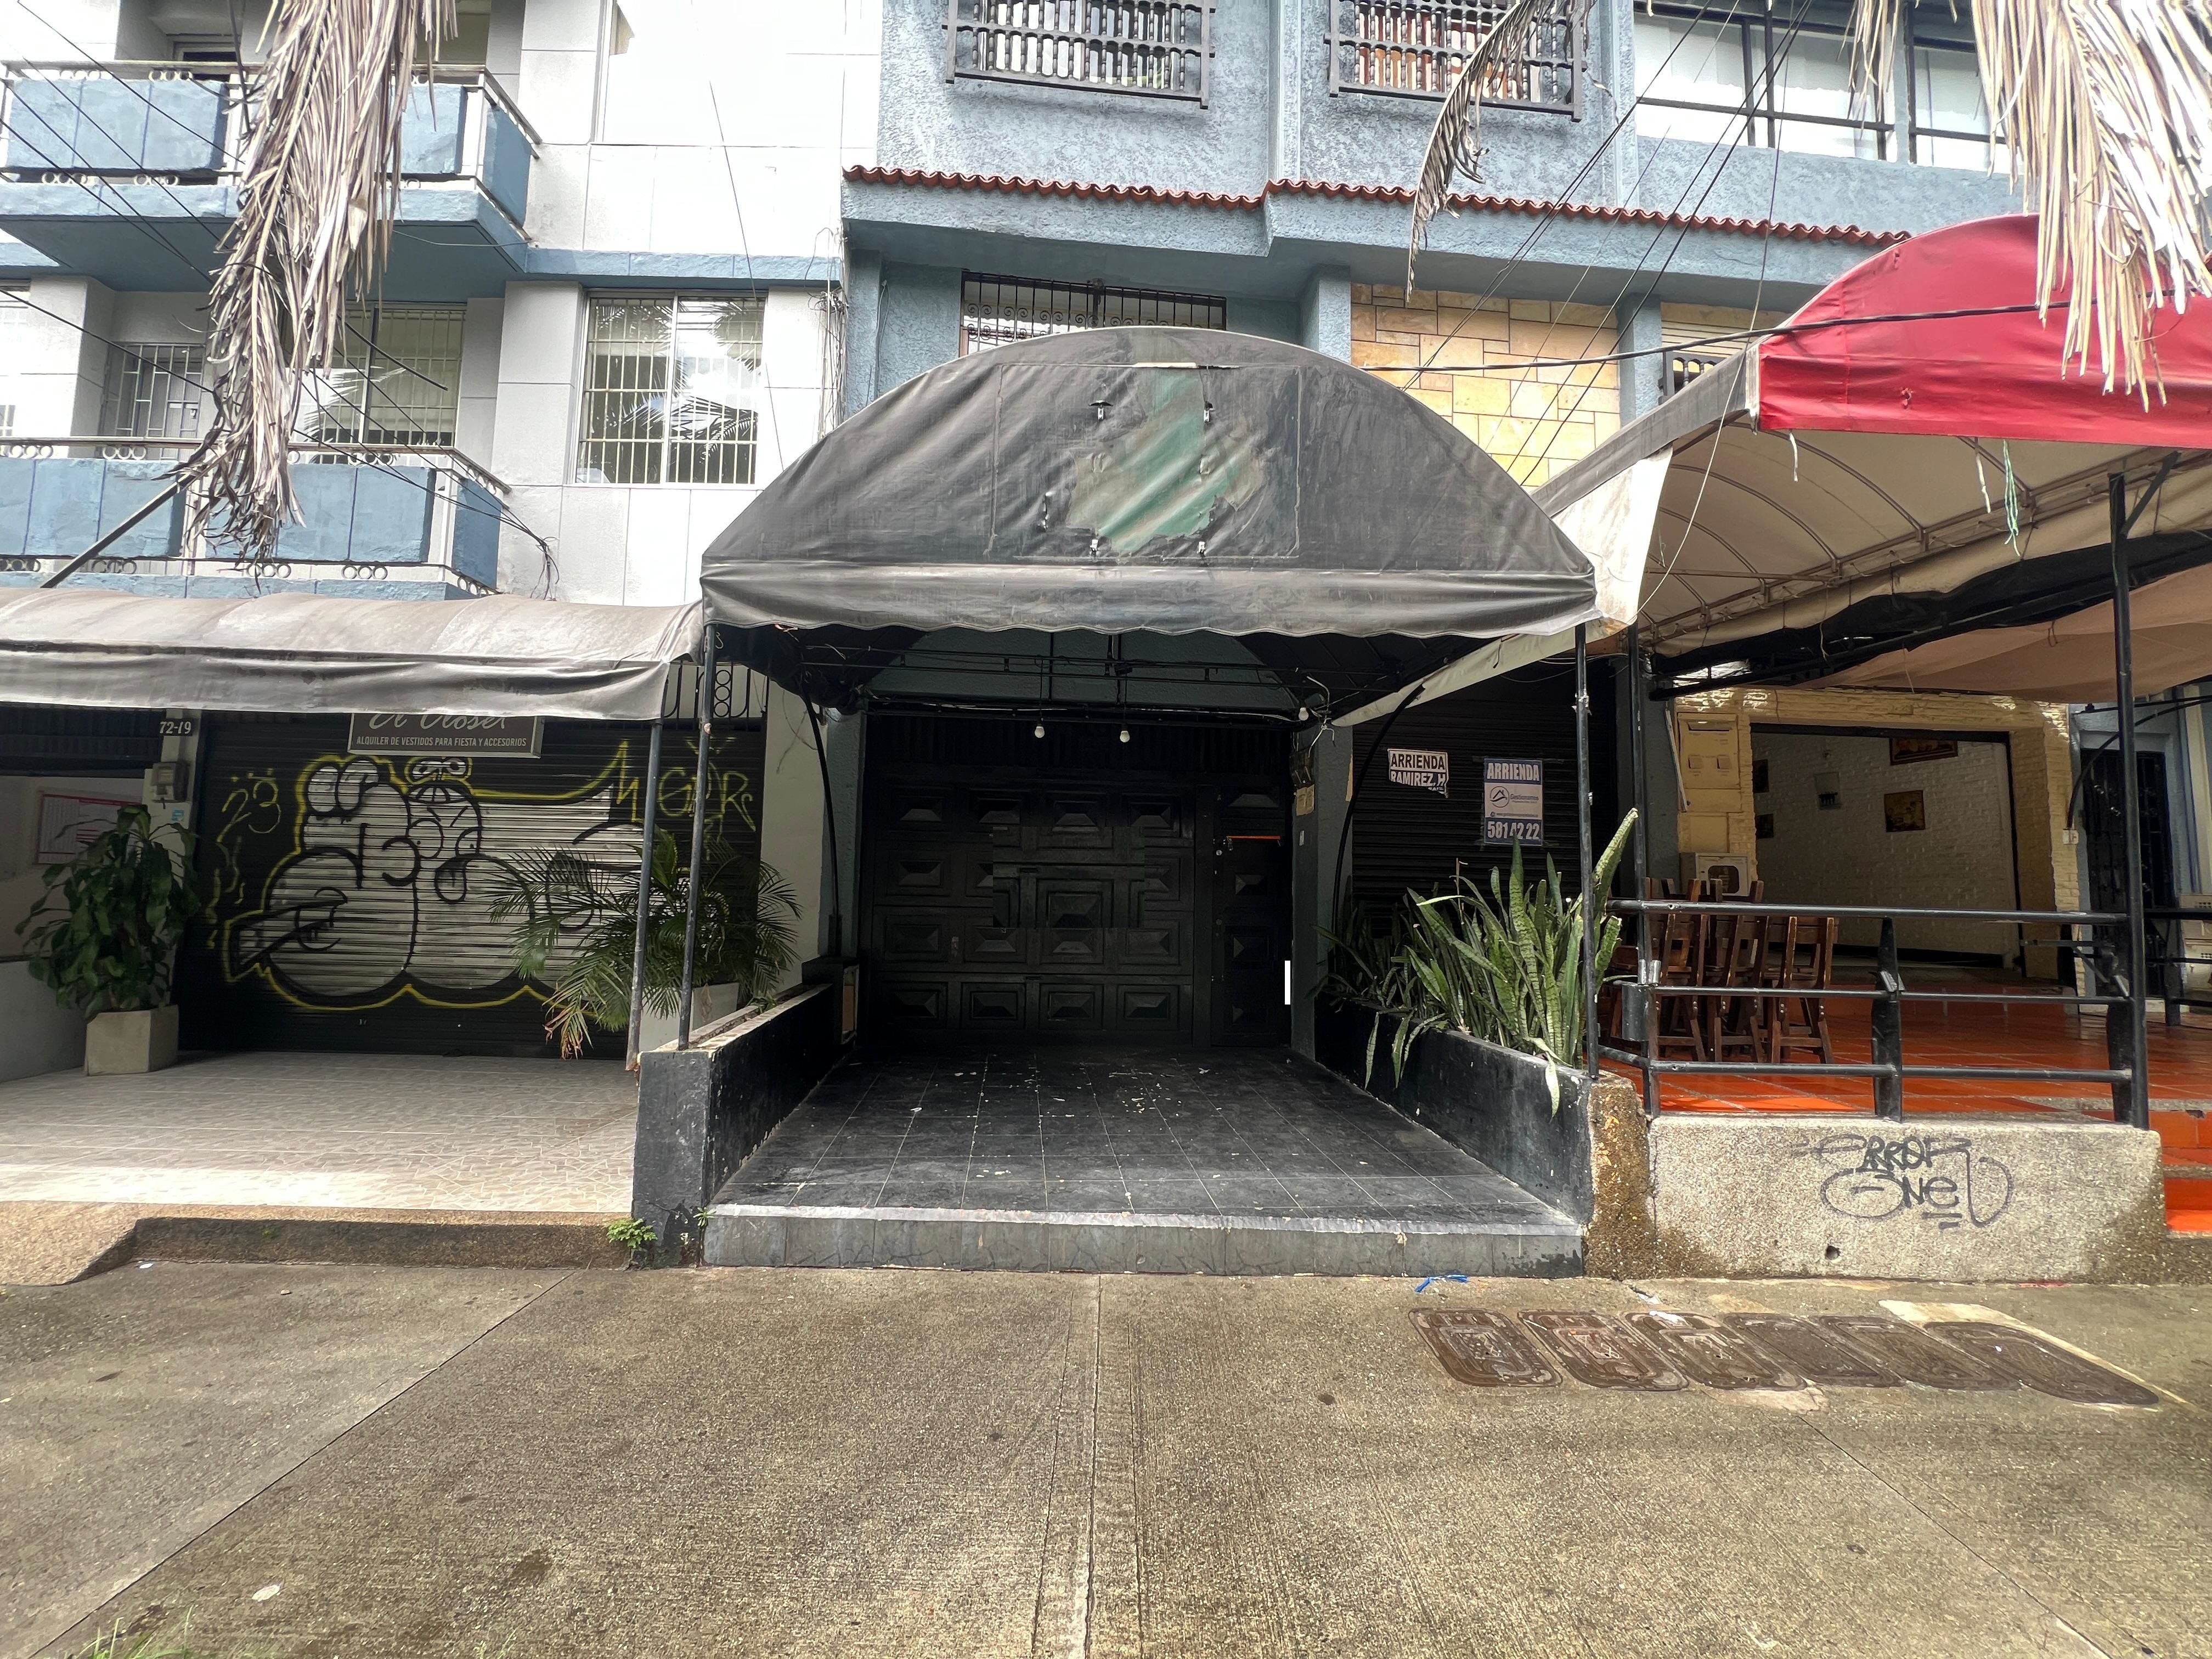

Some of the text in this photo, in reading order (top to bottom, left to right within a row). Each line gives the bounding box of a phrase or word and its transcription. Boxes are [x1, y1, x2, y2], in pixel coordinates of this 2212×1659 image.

[160, 721, 192, 734] 72-19
[356, 736, 527, 747] ALQUILER DE VESTIDOS PARA FIESTA Y ACCESORIOS
[1391, 753, 1445, 770] ARRIENDA
[1487, 763, 1540, 781] ARRIENDA
[1487, 821, 1508, 839] 581
[1526, 823, 1540, 840] 22
